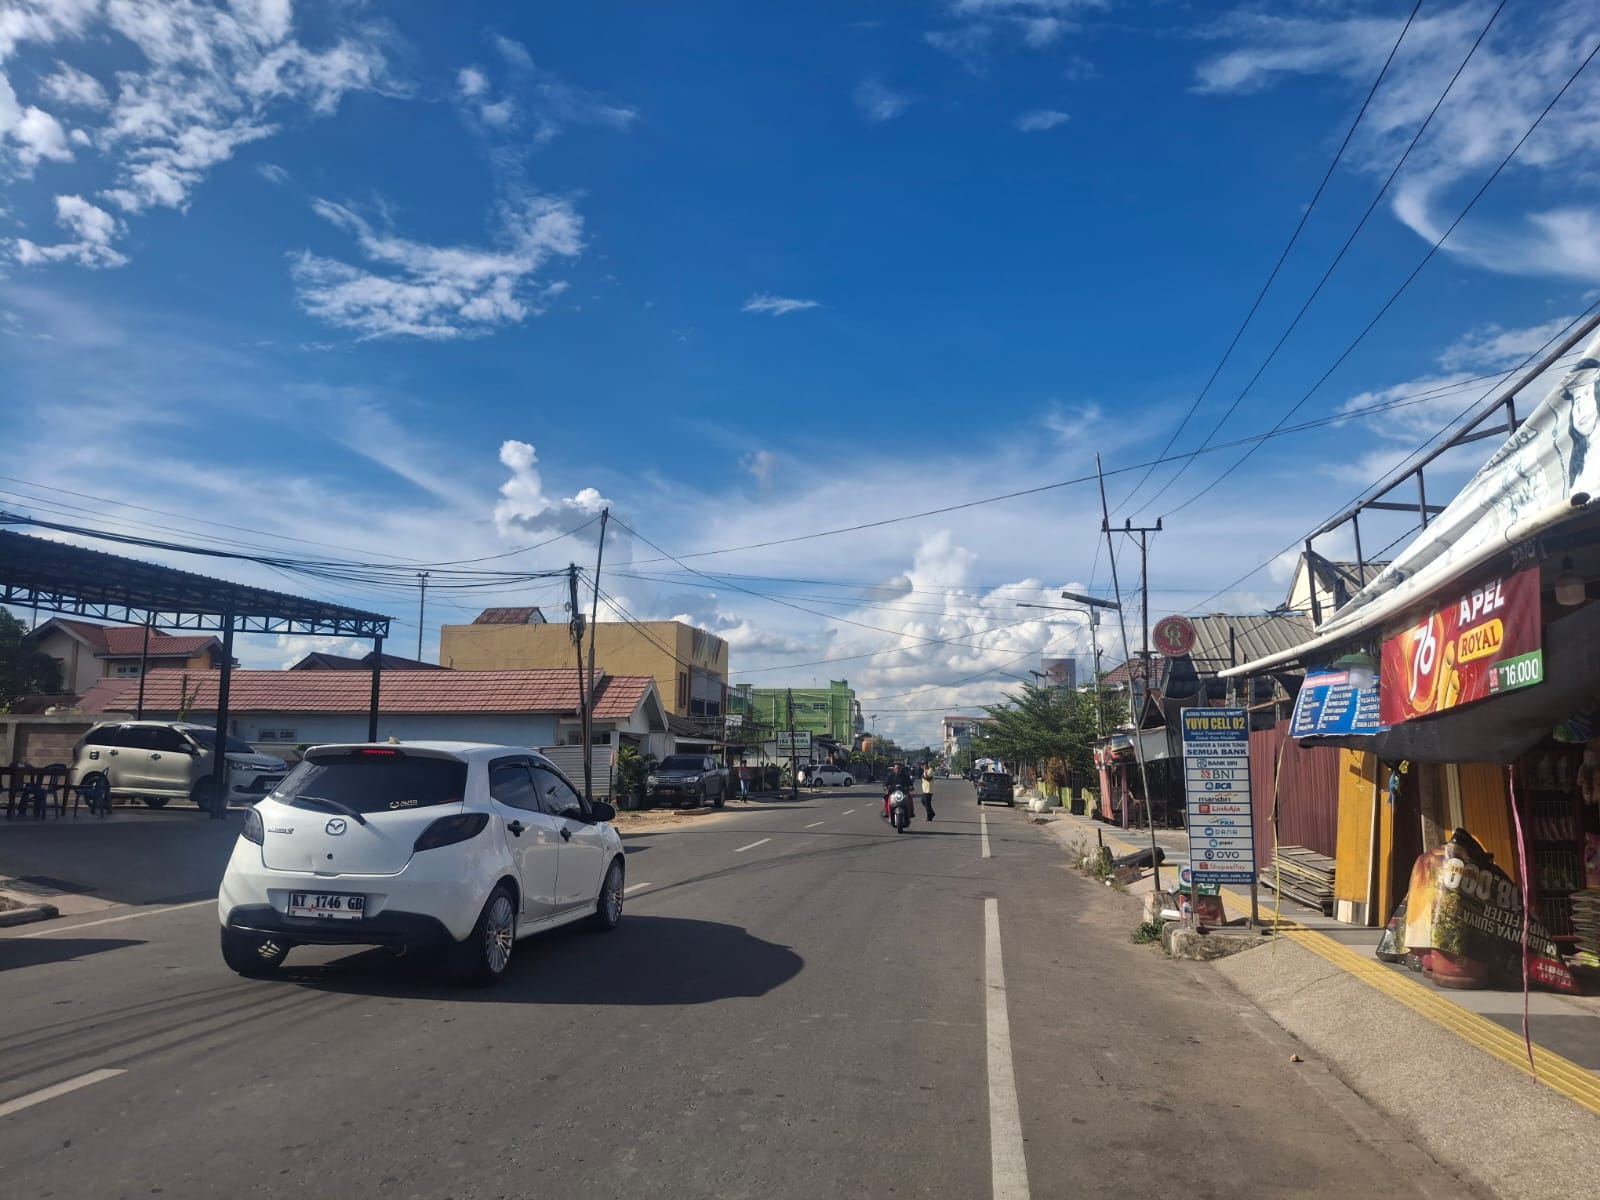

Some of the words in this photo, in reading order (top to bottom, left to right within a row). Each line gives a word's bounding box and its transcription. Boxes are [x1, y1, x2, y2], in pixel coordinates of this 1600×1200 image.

[1459, 578, 1504, 626] APEL
[1461, 626, 1500, 657] ROYAL
[1410, 609, 1436, 700] 76
[1505, 658, 1539, 686] 16.000
[1185, 717, 1209, 729] YUYU
[1211, 717, 1231, 729] CELL
[1233, 717, 1245, 729] 02
[1213, 770, 1234, 778] BNI
[1445, 858, 1521, 912] 18.000
[292, 894, 307, 907] KT
[315, 895, 341, 909] 1746
[1463, 910, 1495, 933] SURYA
[1484, 904, 1520, 928] FILTER
[1537, 962, 1571, 979] ERBIT
